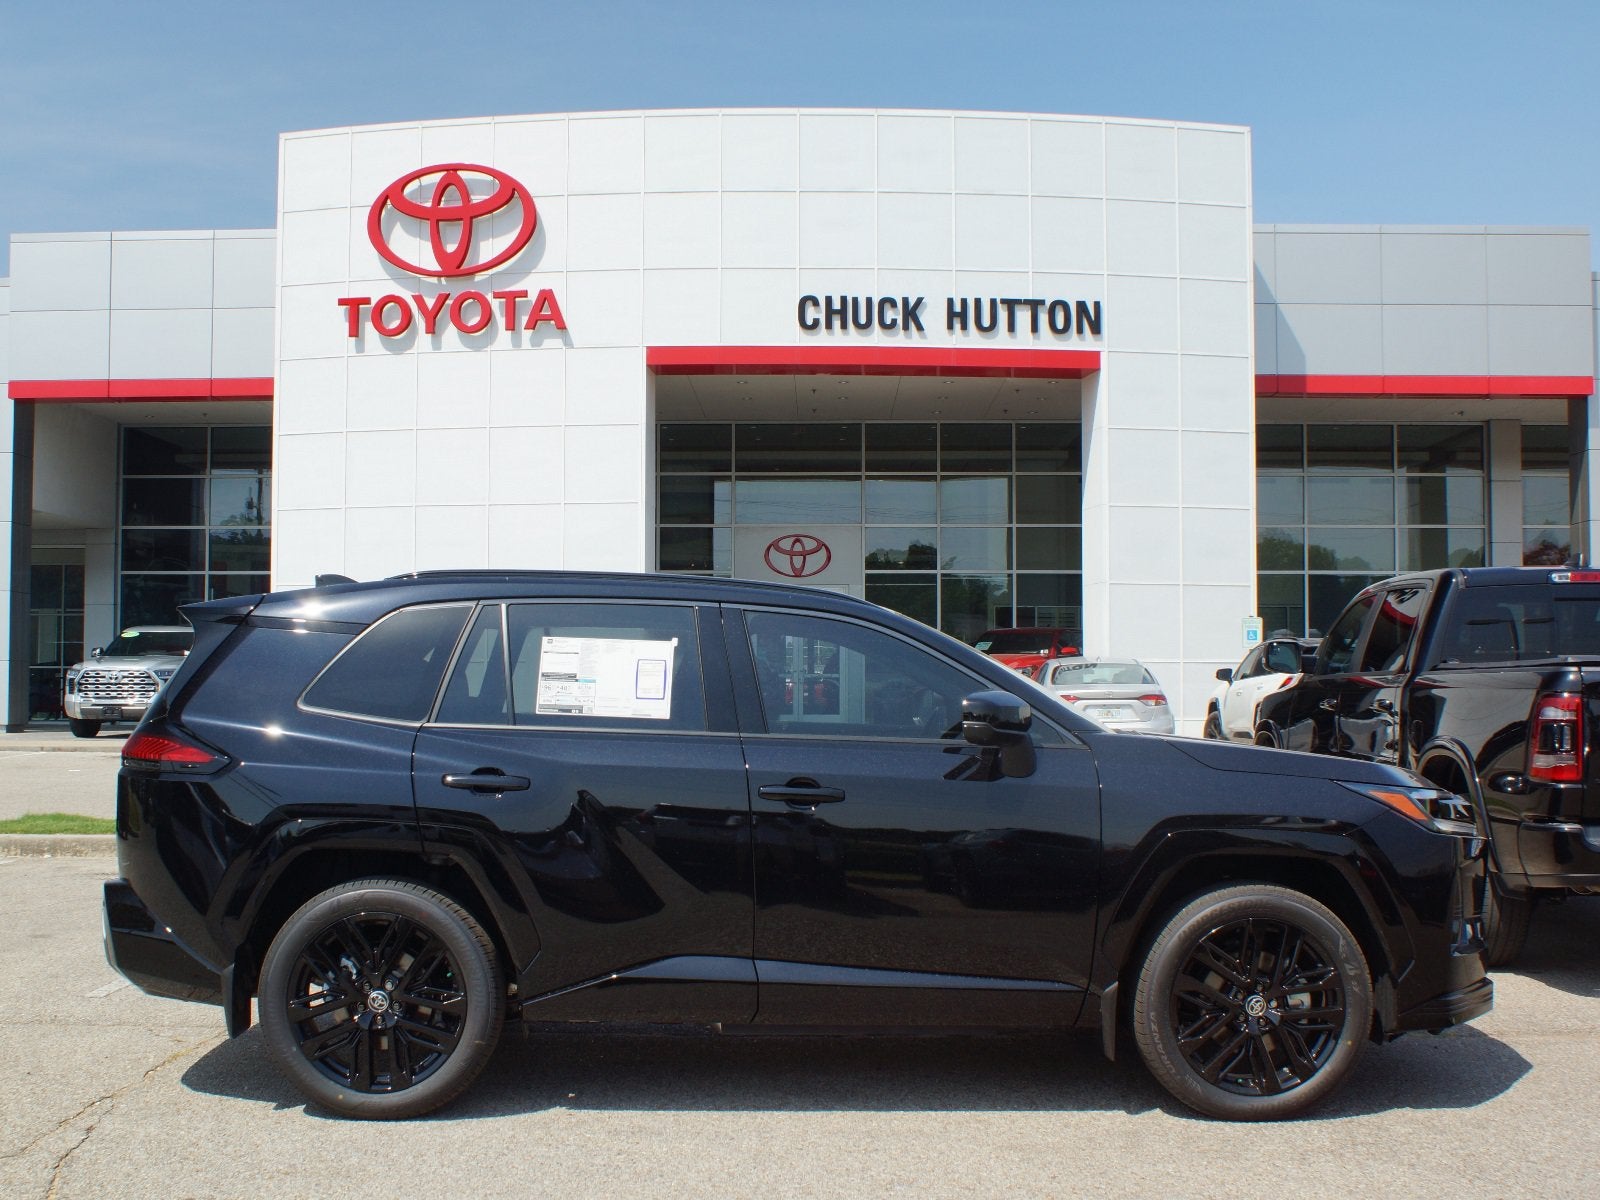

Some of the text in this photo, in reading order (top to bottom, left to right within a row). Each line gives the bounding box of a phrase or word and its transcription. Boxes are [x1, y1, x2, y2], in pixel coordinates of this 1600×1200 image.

[338, 289, 567, 338] TOYOTA
[798, 295, 1101, 335] CHUCK HUTTON
